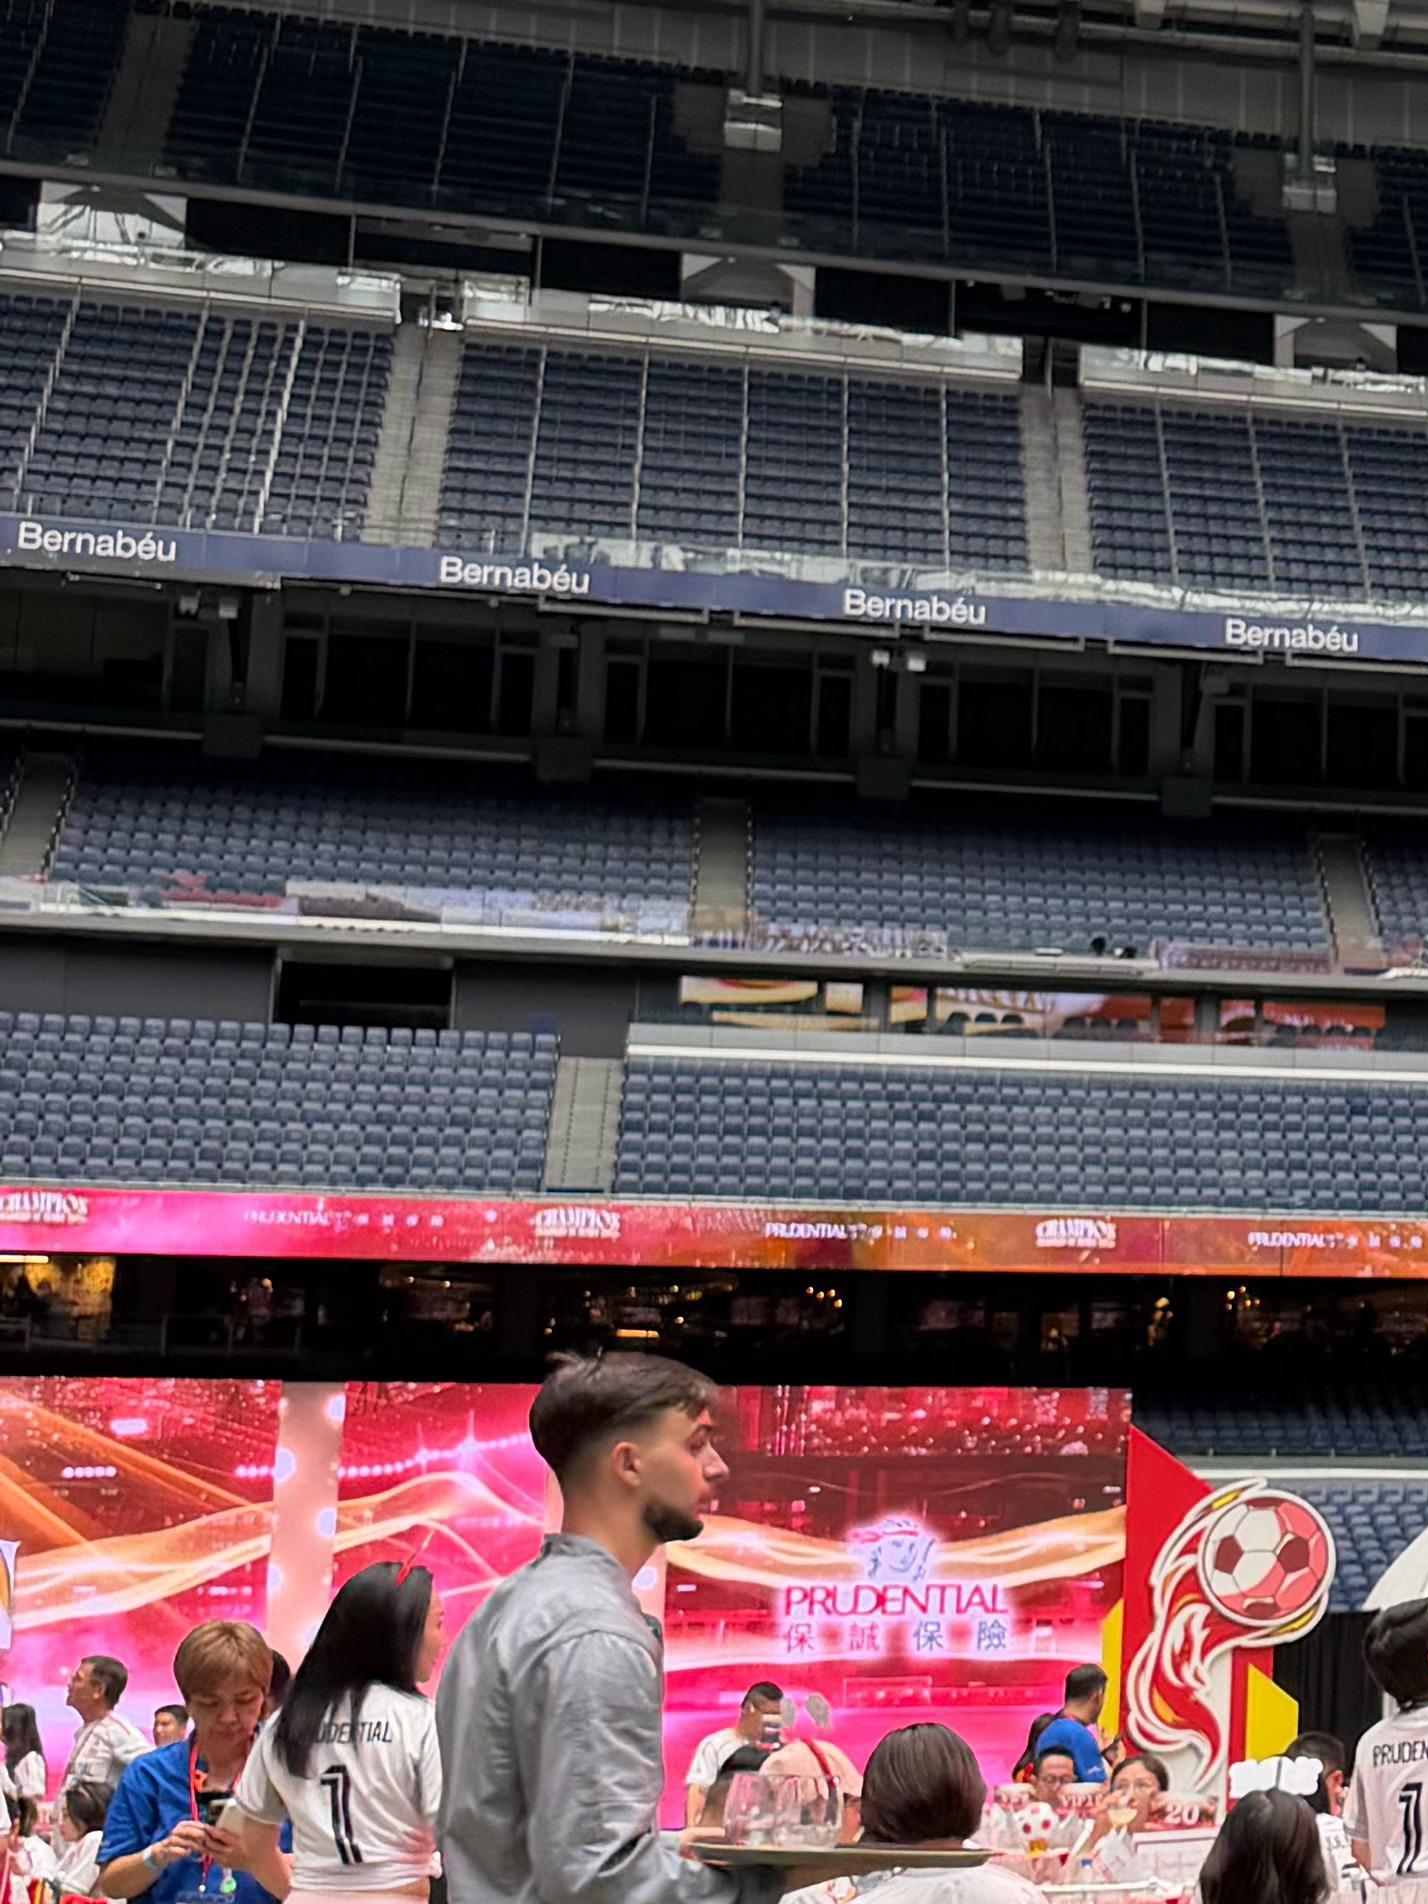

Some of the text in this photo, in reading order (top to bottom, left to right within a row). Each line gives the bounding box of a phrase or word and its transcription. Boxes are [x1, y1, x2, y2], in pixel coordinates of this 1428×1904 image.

[17, 521, 178, 564] Bernabéu
[440, 555, 590, 595] Bernabéu
[843, 588, 986, 626] Bernabéu
[1225, 618, 1358, 654] Bernabéu
[784, 1584, 1009, 1616] PRUDENTIAL
[781, 1617, 1009, 1653] 保誠保險
[320, 1764, 363, 1865] 1
[1396, 1781, 1423, 1876] 1
